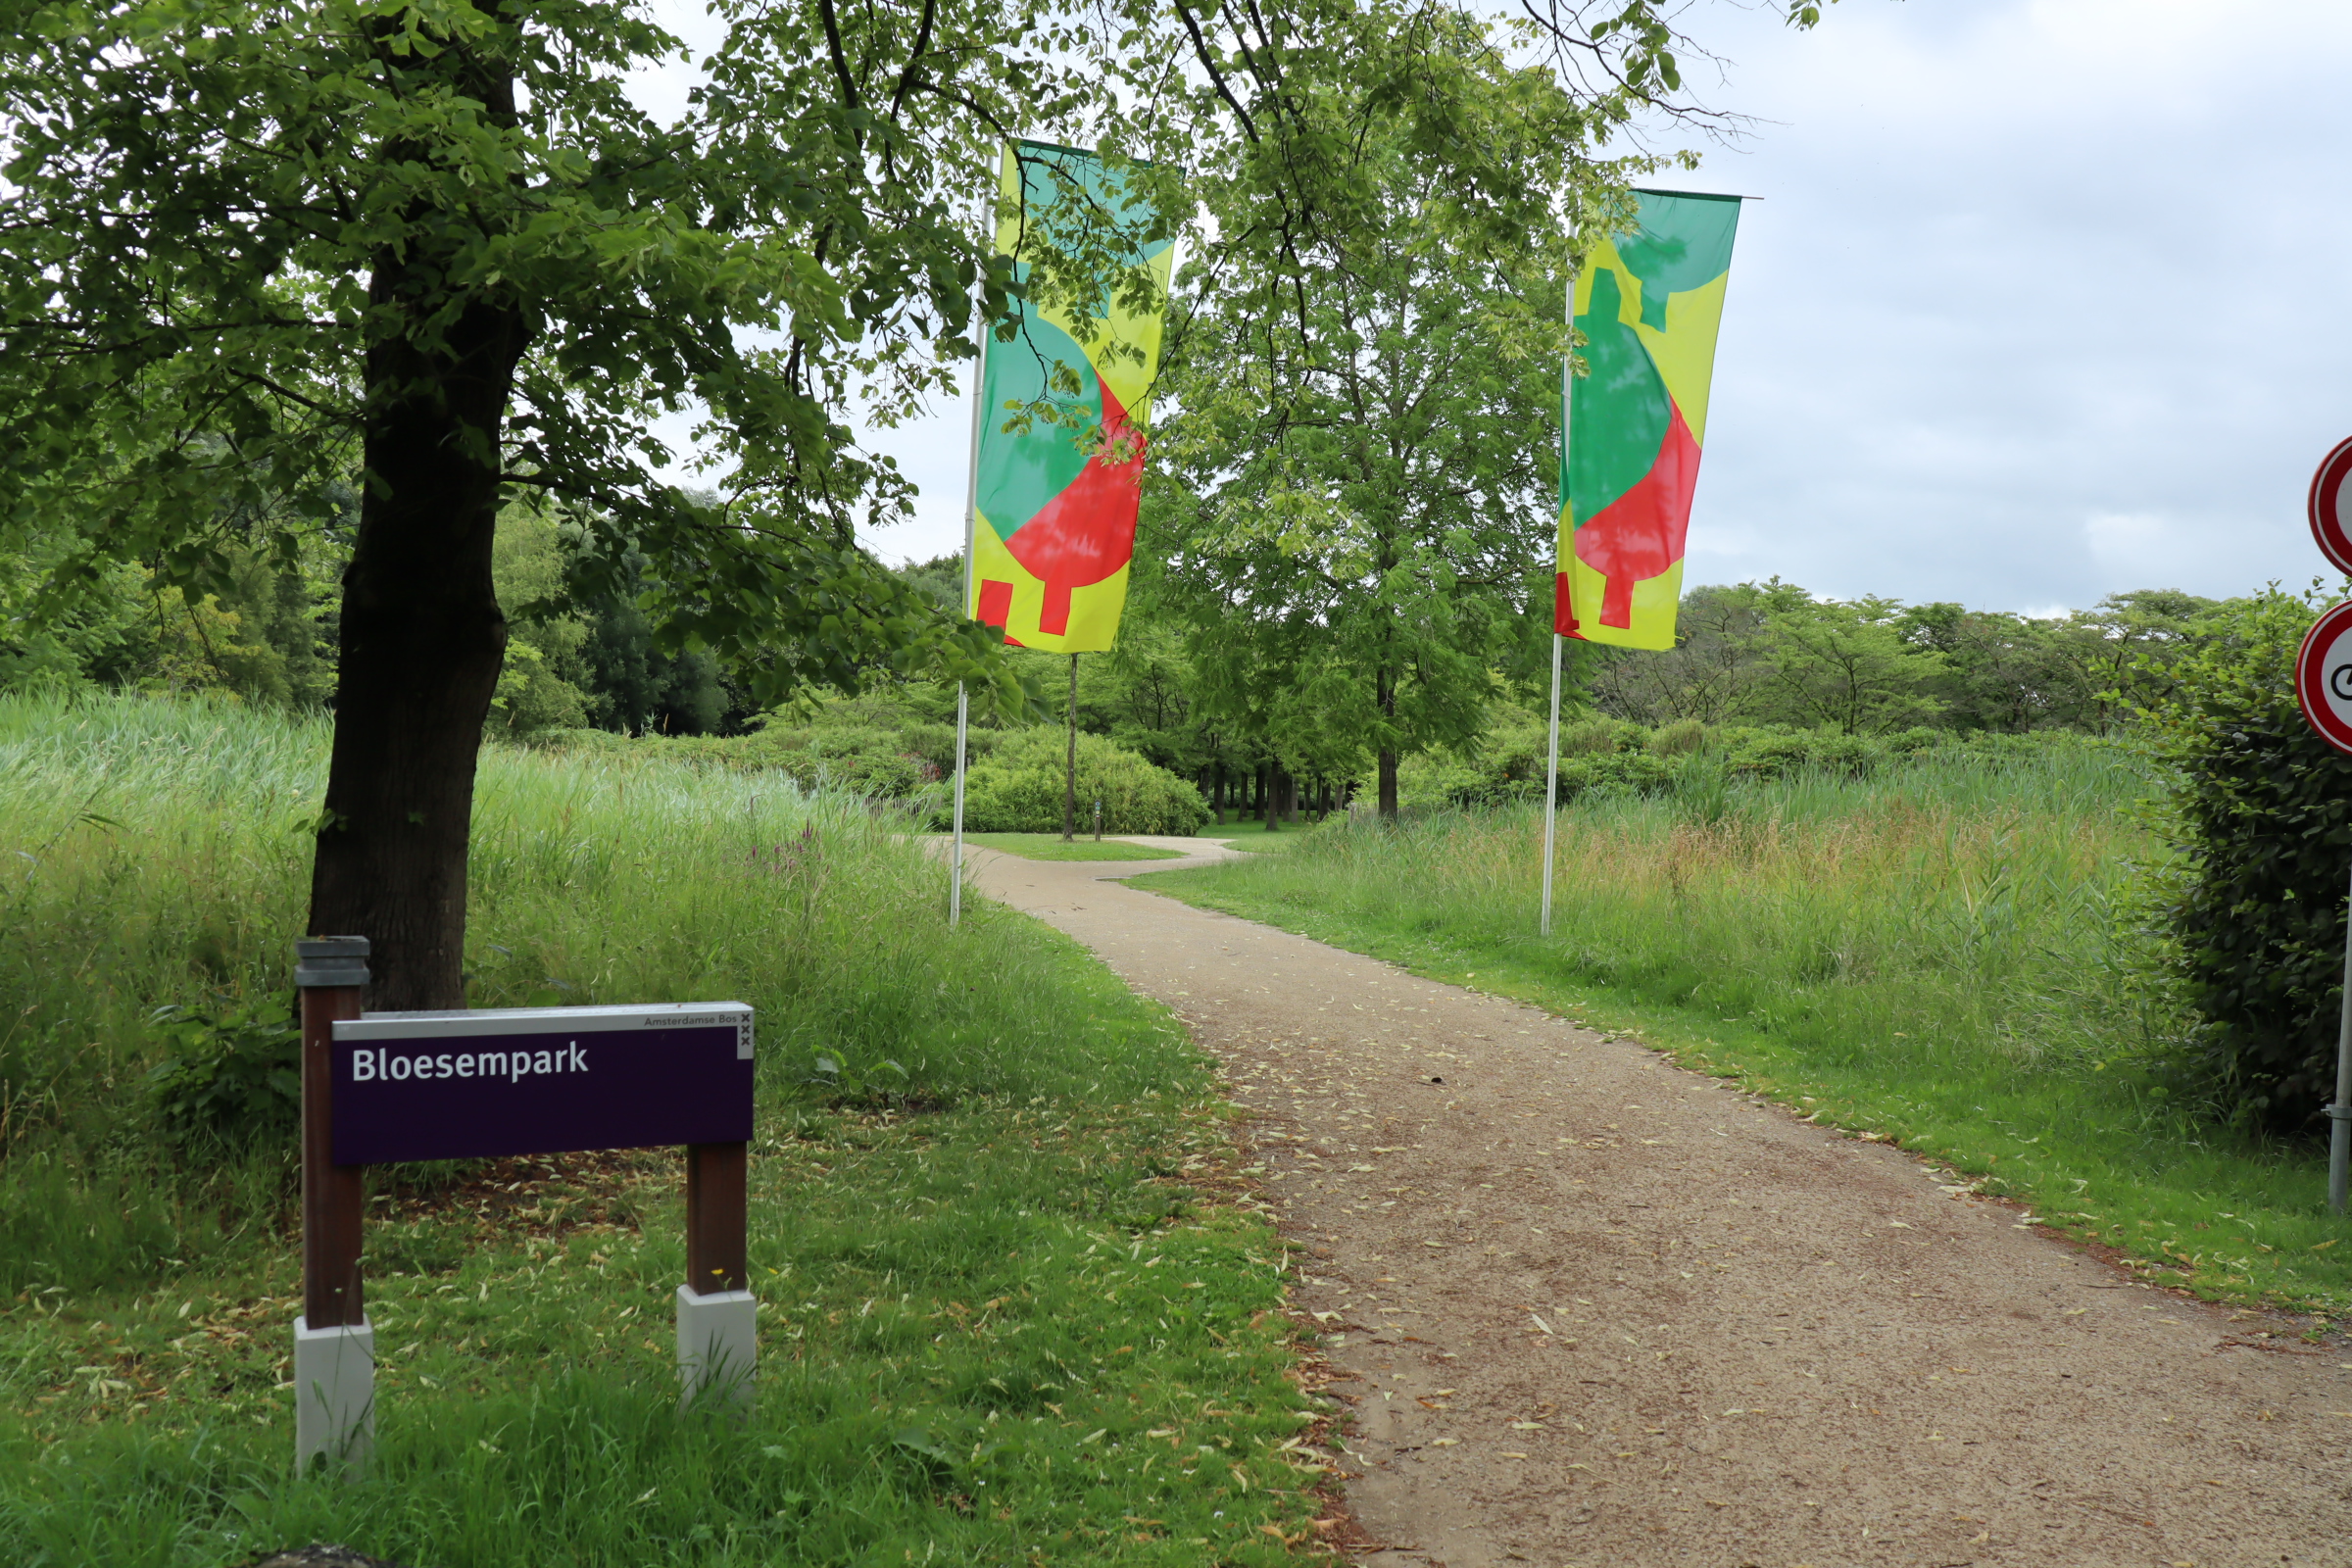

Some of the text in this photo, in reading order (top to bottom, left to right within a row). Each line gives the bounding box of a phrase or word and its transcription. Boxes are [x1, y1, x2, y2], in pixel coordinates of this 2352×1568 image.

[644, 1014, 737, 1026] Amsterdamse Bos
[353, 1041, 589, 1084] Bloesempark
